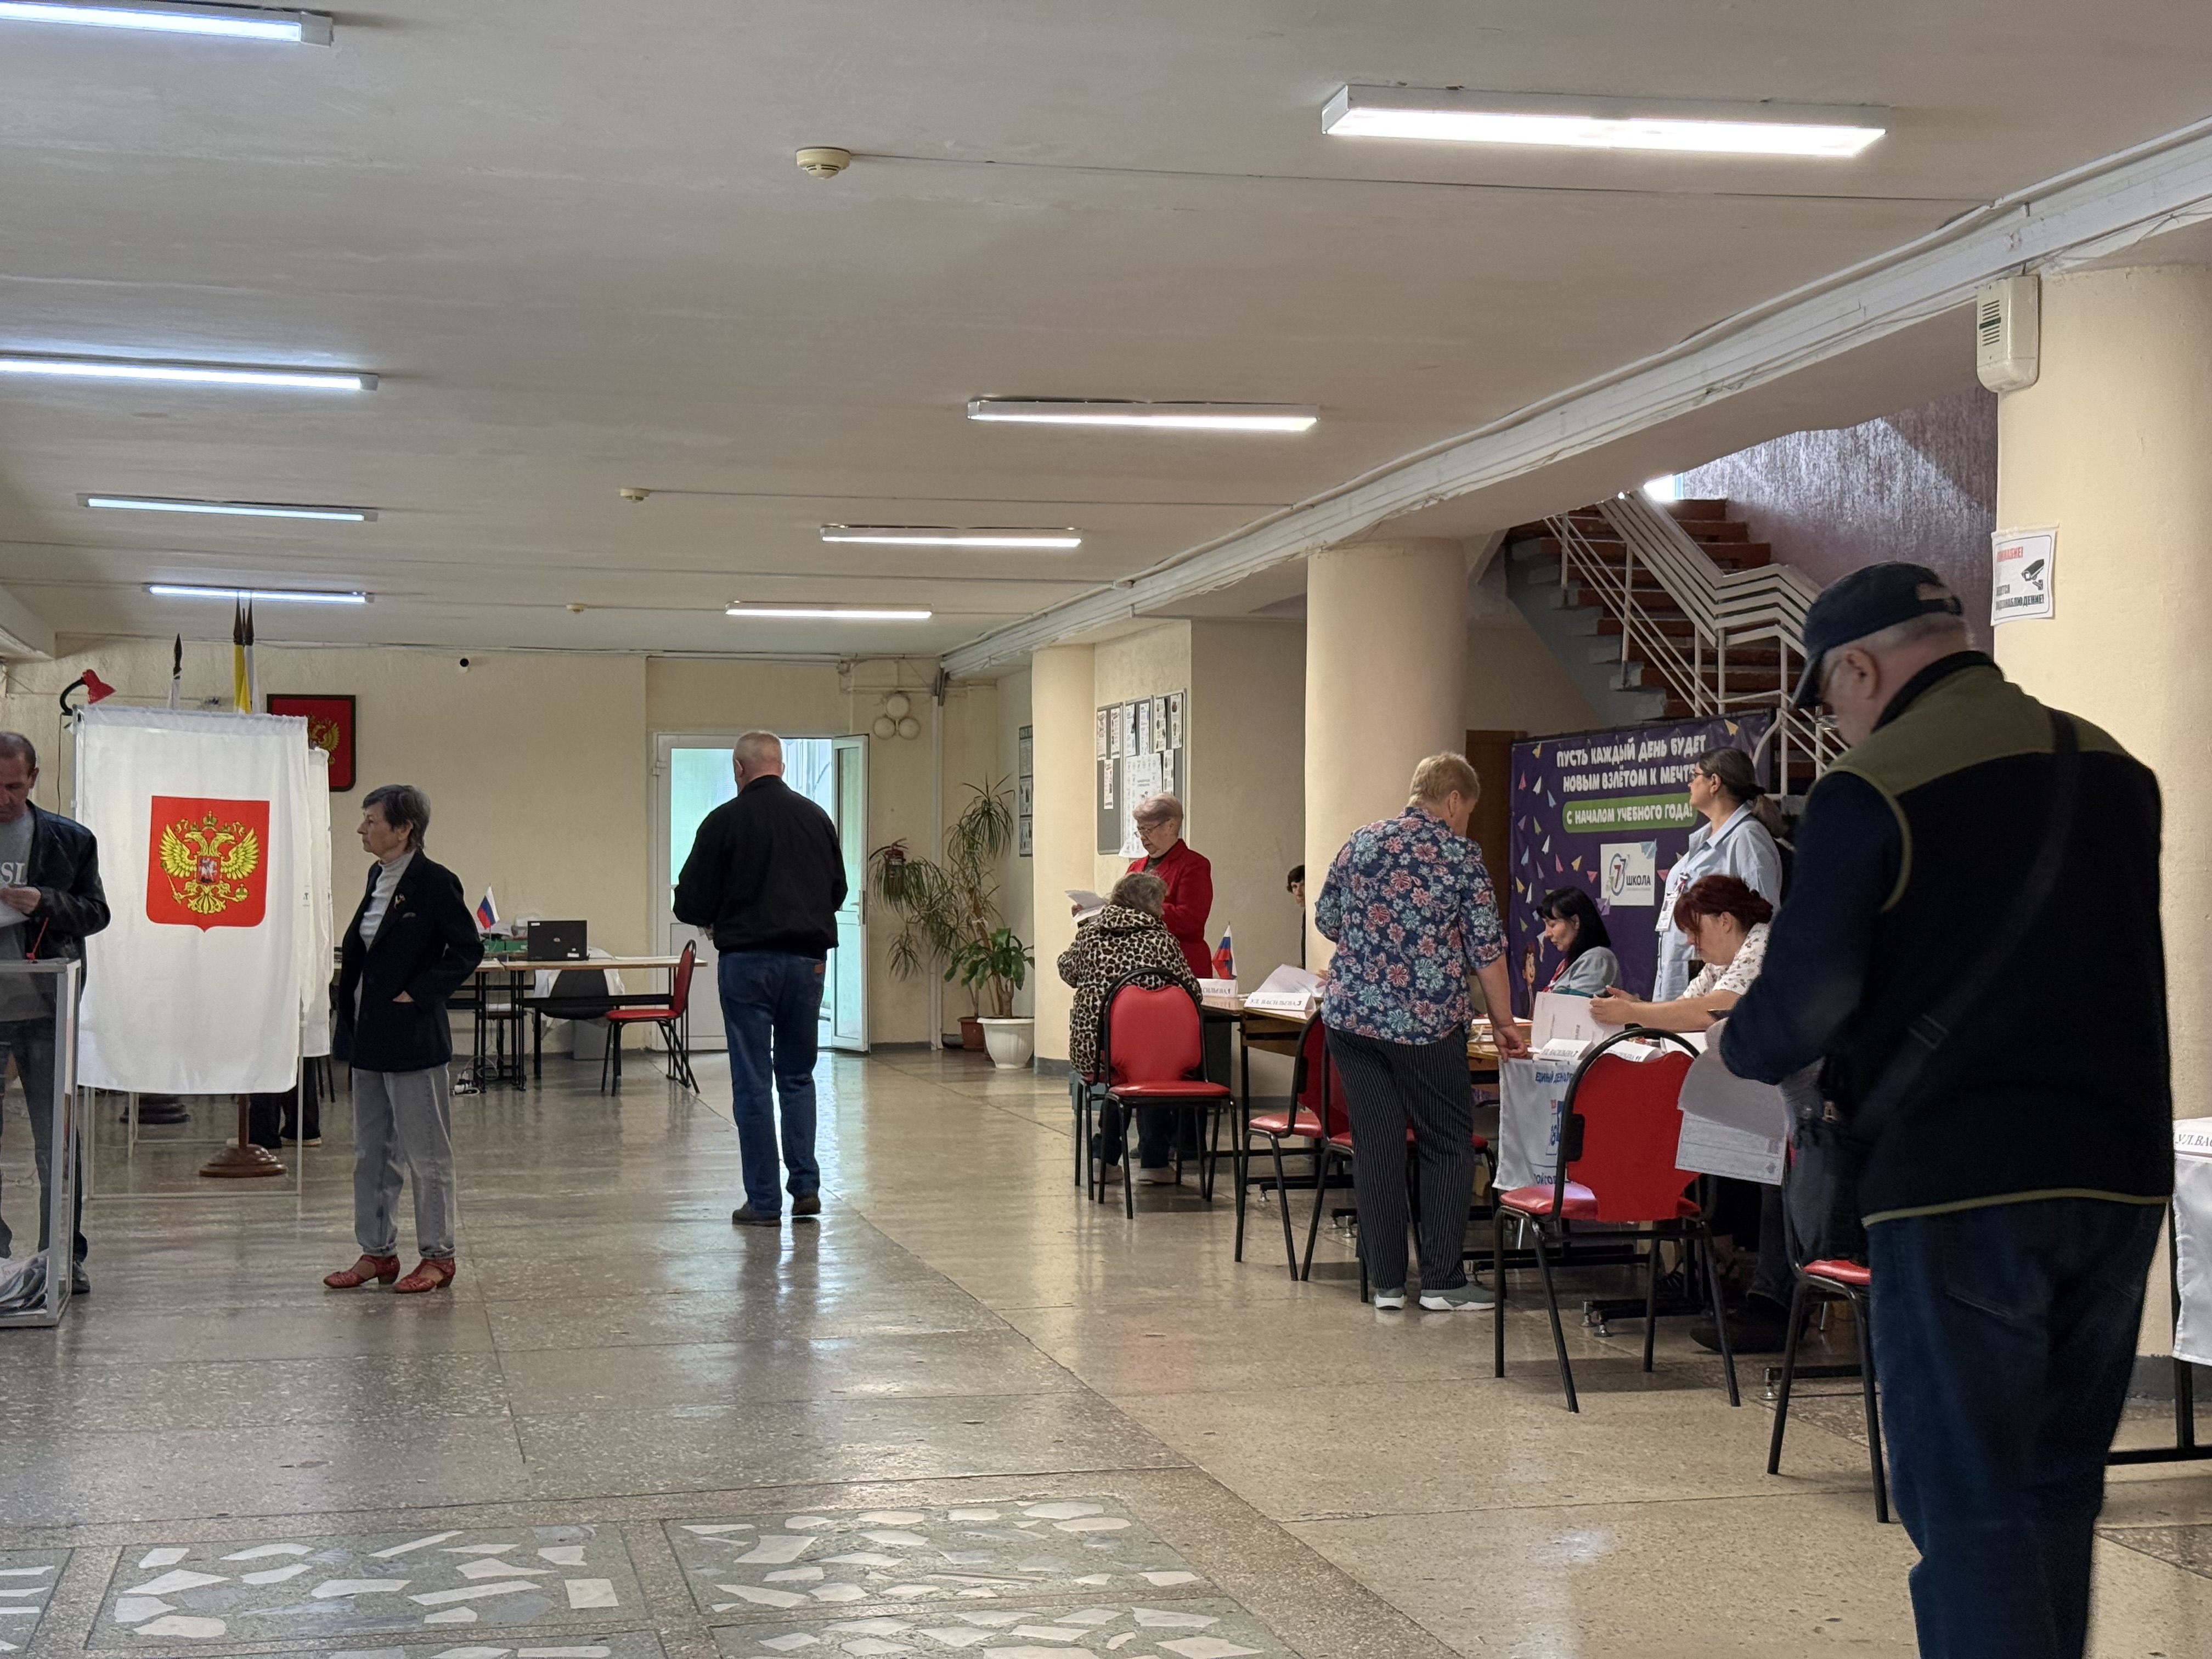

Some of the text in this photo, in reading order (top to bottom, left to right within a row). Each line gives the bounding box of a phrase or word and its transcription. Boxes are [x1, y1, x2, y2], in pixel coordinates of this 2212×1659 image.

[1556, 735, 1707, 768] ПУСТЬ КАЖДЫЙ ДЕНЬ БУДЕТ
[1564, 773, 1600, 792] НОВЫМ
[1602, 765, 1647, 789] ВЗЛЁТОМ
[1650, 771, 1657, 785] К
[1567, 803, 1693, 825] С НАЧАЛОМ УЧЕБНОГО ГОДА!
[1626, 874, 1651, 886] ШКОЛА
